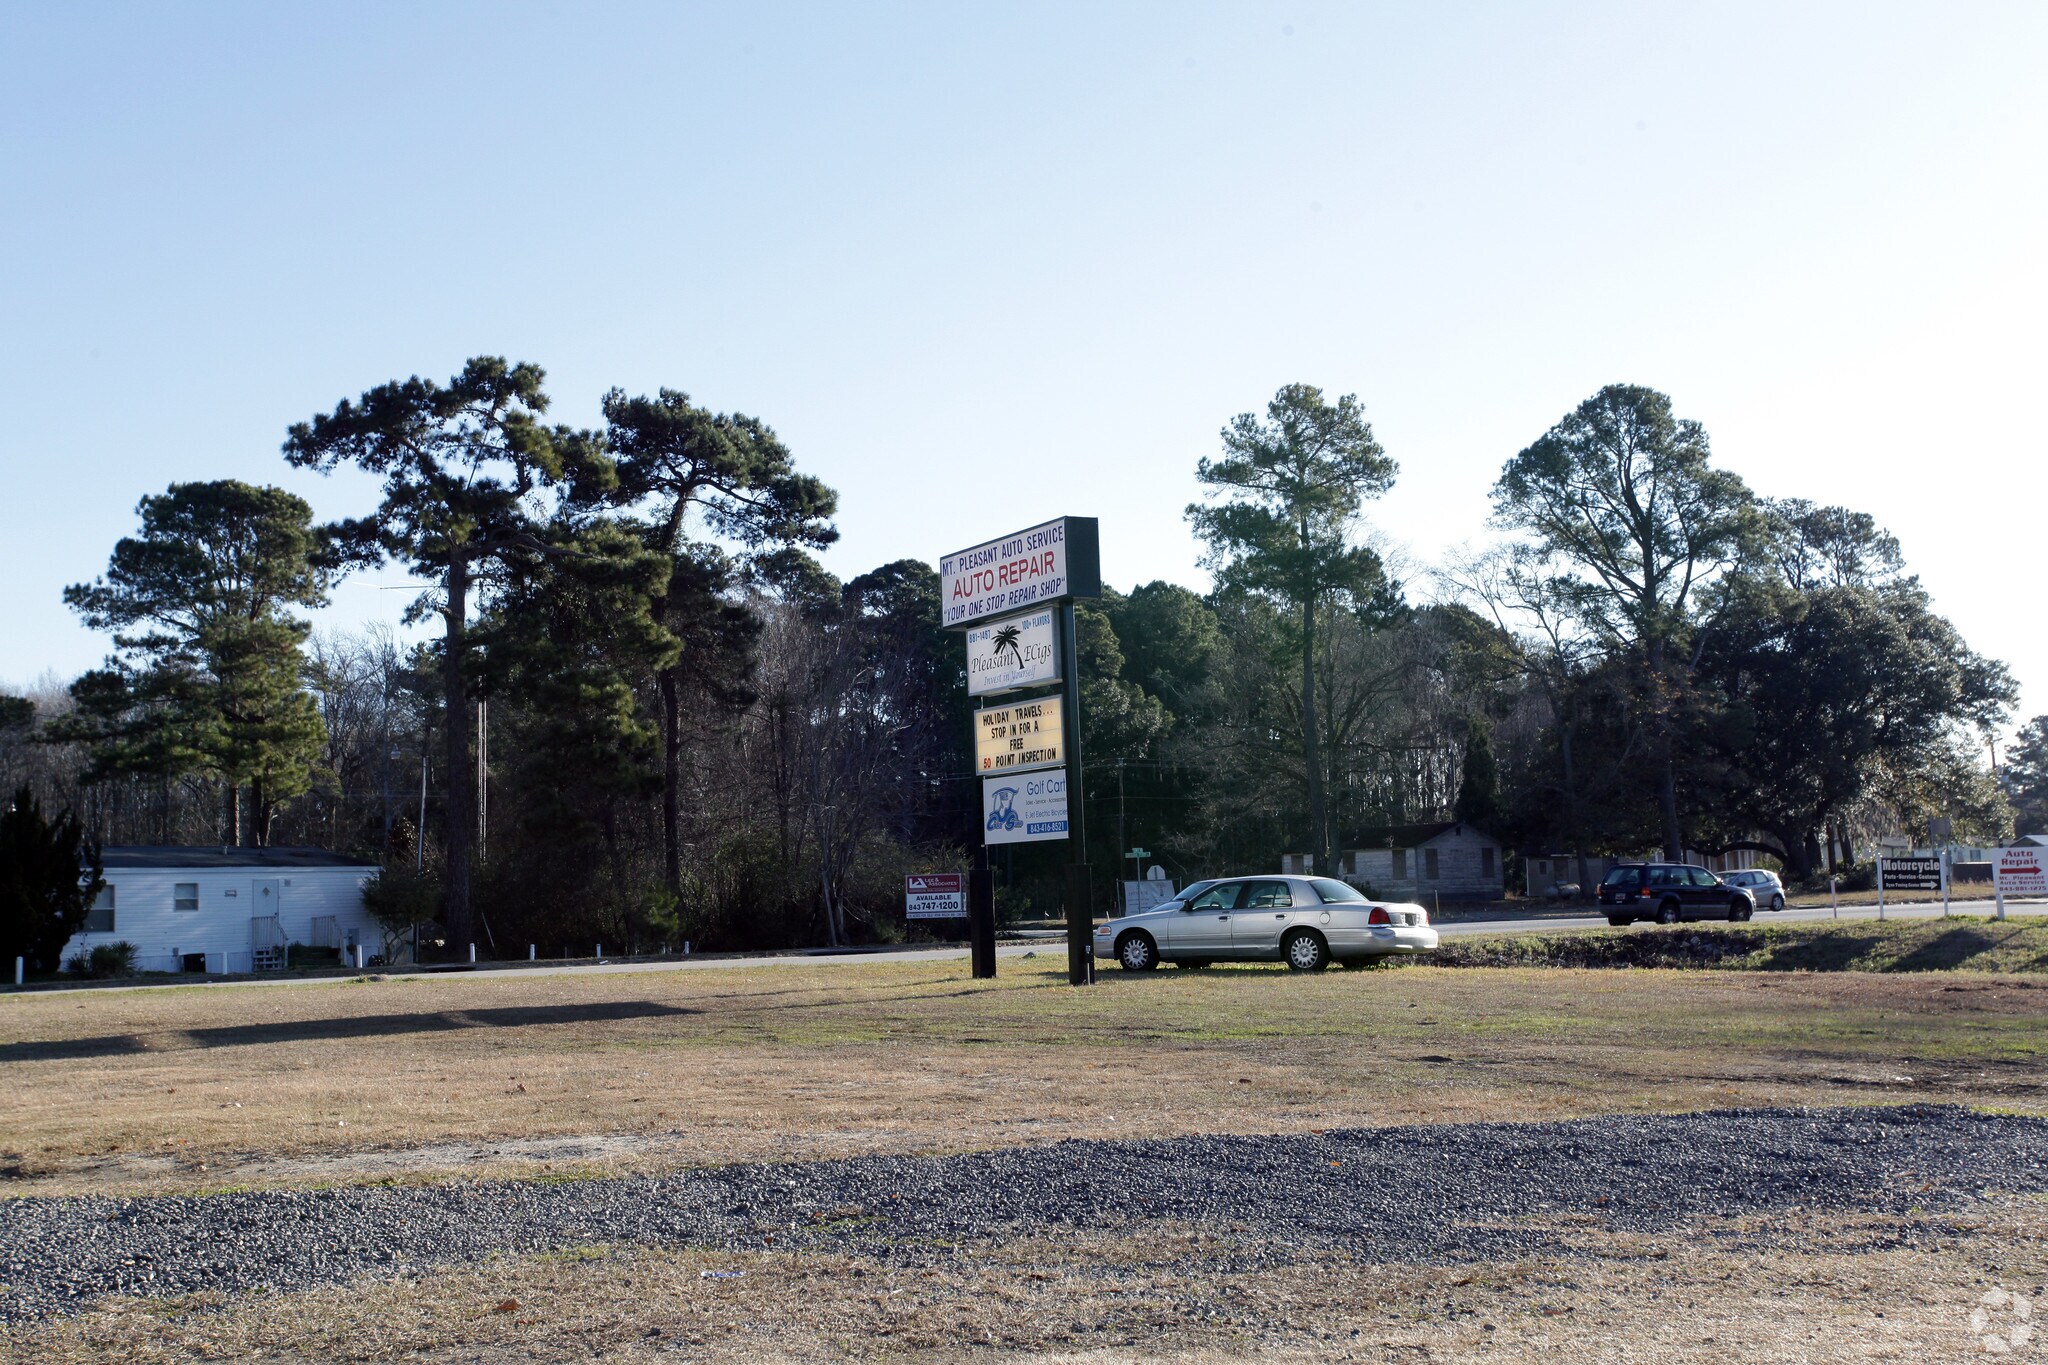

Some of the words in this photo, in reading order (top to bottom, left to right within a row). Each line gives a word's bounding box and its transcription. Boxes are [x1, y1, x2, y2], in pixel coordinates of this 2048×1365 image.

[942, 560, 956, 577] MT.
[959, 547, 998, 573] PLEASANT
[1002, 538, 1023, 560] AUTO
[1026, 525, 1064, 551] SERVICE
[953, 569, 994, 600] AUTO
[999, 551, 1055, 588] REPAIR
[968, 598, 982, 617] ONE
[986, 593, 1005, 612] STOP
[1008, 585, 1037, 606] REPAIR
[1032, 614, 1051, 628] FLAVORS
[971, 651, 1015, 673] Pleasant
[1024, 643, 1052, 664] ECigs
[984, 674, 1002, 686] Invest
[1003, 673, 1010, 682] in
[1011, 664, 1036, 683] Yourself
[983, 711, 1010, 726] HOLIDAY
[991, 726, 1007, 739] STOP
[1009, 724, 1017, 735] IN
[1020, 722, 1031, 735] FOR
[1034, 720, 1039, 732] A
[1009, 738, 1024, 751] FREE
[983, 757, 992, 769] 50
[996, 753, 1015, 767] POINT
[1018, 747, 1057, 764] INSPECTION
[1026, 780, 1045, 796] Golf
[1030, 821, 1065, 833] 843-416-8521
[1882, 859, 1940, 873] Motorcycle
[2001, 858, 2039, 867] Repair
